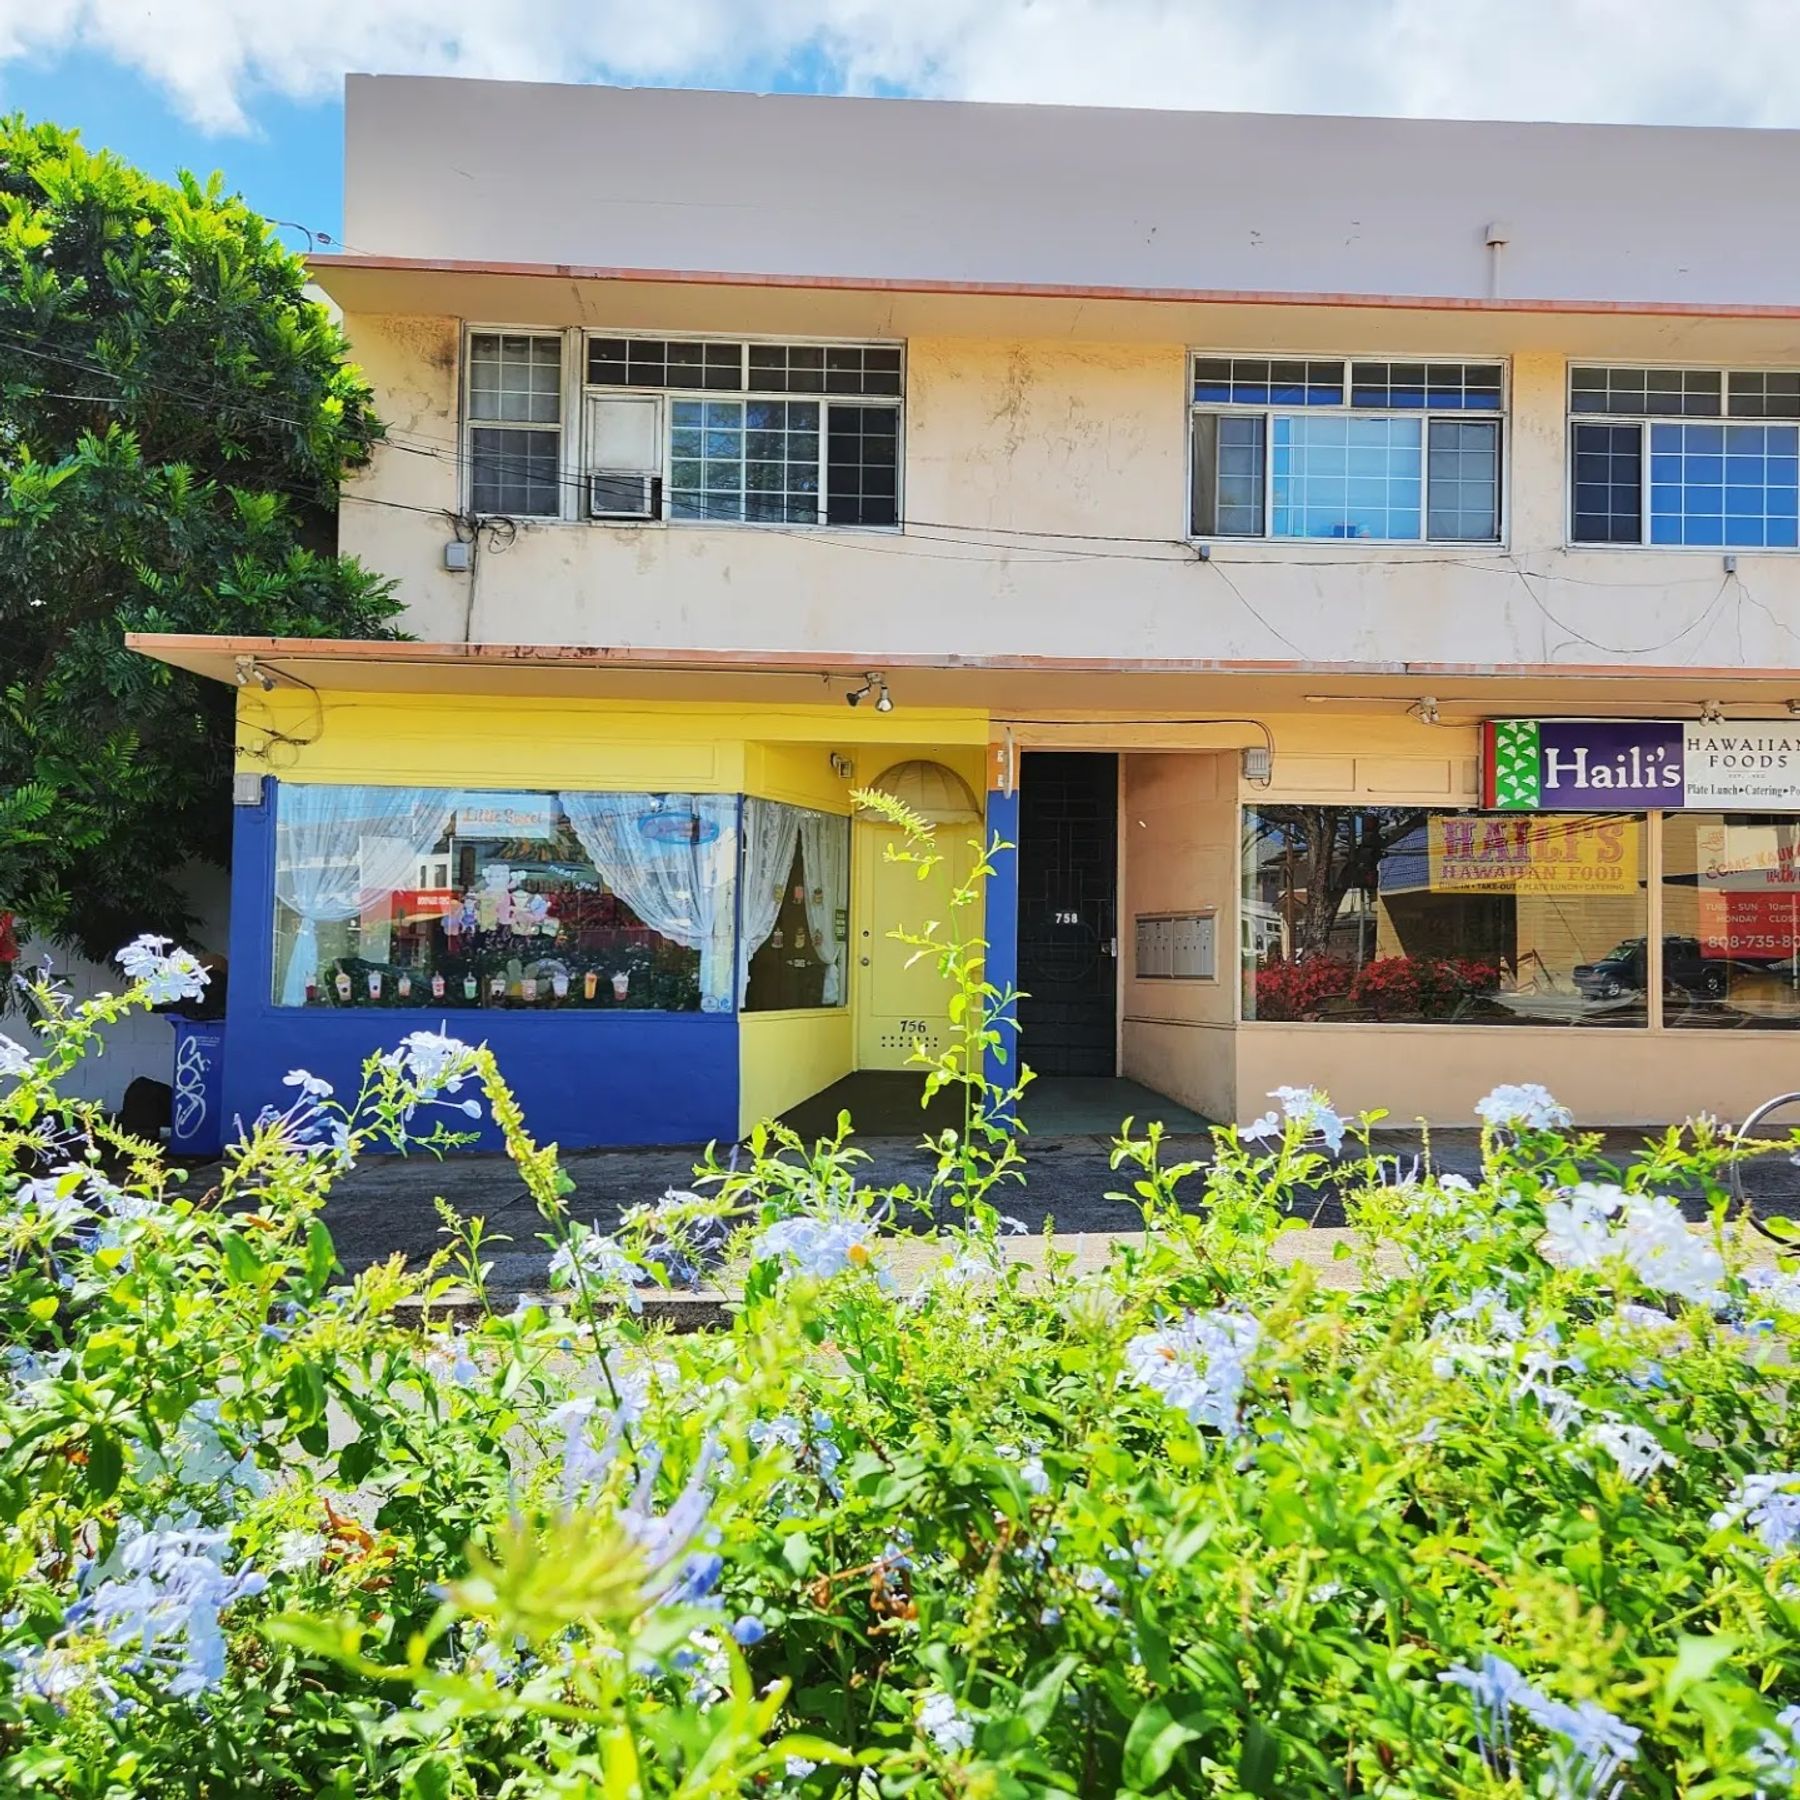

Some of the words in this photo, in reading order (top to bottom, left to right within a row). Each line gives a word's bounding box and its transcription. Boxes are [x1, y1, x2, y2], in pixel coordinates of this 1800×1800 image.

[1544, 747, 1682, 789] Haili's
[1709, 755, 1787, 768] FOODS
[1687, 784, 1708, 795] Plate
[1711, 784, 1738, 795] Lunch
[1745, 784, 1783, 798] Catering
[1442, 820, 1624, 863] HAILI'S
[1441, 865, 1557, 880] HAWAIIAN
[1568, 866, 1624, 881] FOOD
[1477, 882, 1516, 890] TAKE-OUT
[1738, 903, 1758, 911] SUN
[1055, 912, 1078, 924] 758
[1716, 915, 1758, 923] MONDAY
[900, 1020, 926, 1033] 756
